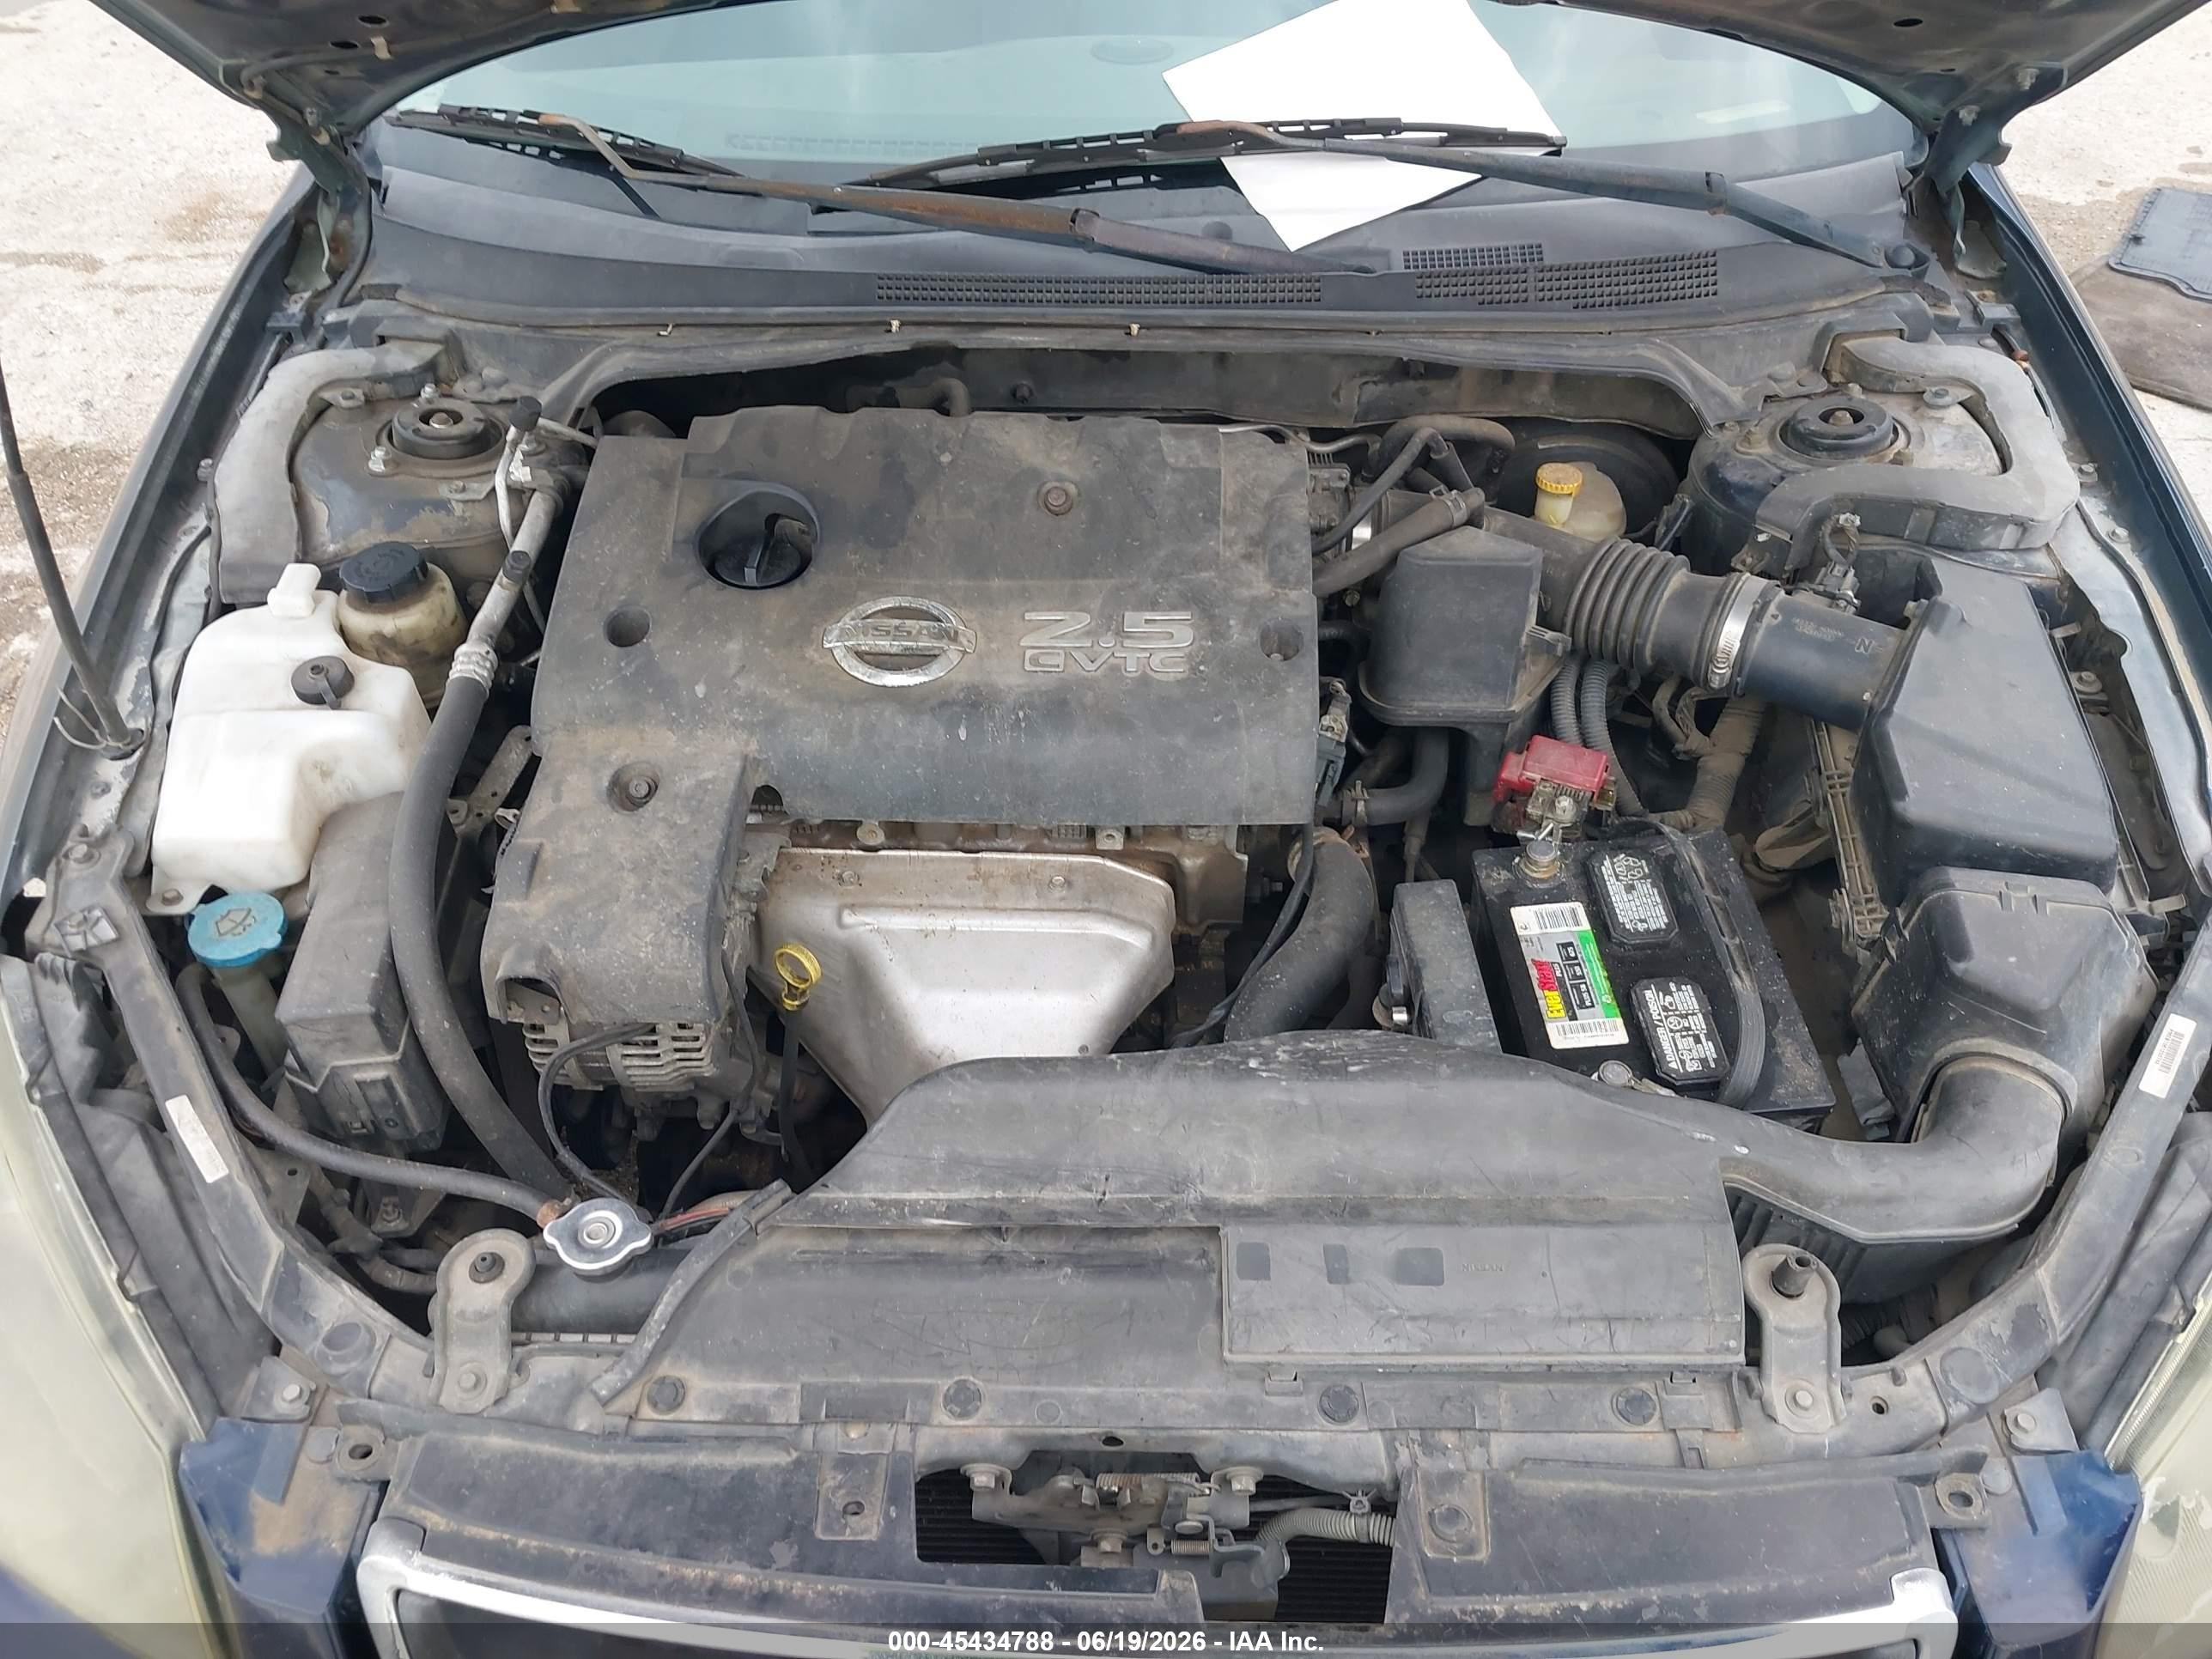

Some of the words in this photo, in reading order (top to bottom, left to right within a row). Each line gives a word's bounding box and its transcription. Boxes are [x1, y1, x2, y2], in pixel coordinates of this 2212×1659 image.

[842, 622, 961, 644] NISSAN
[1019, 611, 1194, 648] 2.5
[1531, 957, 1566, 1019] EverStart
[1643, 989, 1662, 1020] POISON
[1656, 1027, 1676, 1061] DANGER
